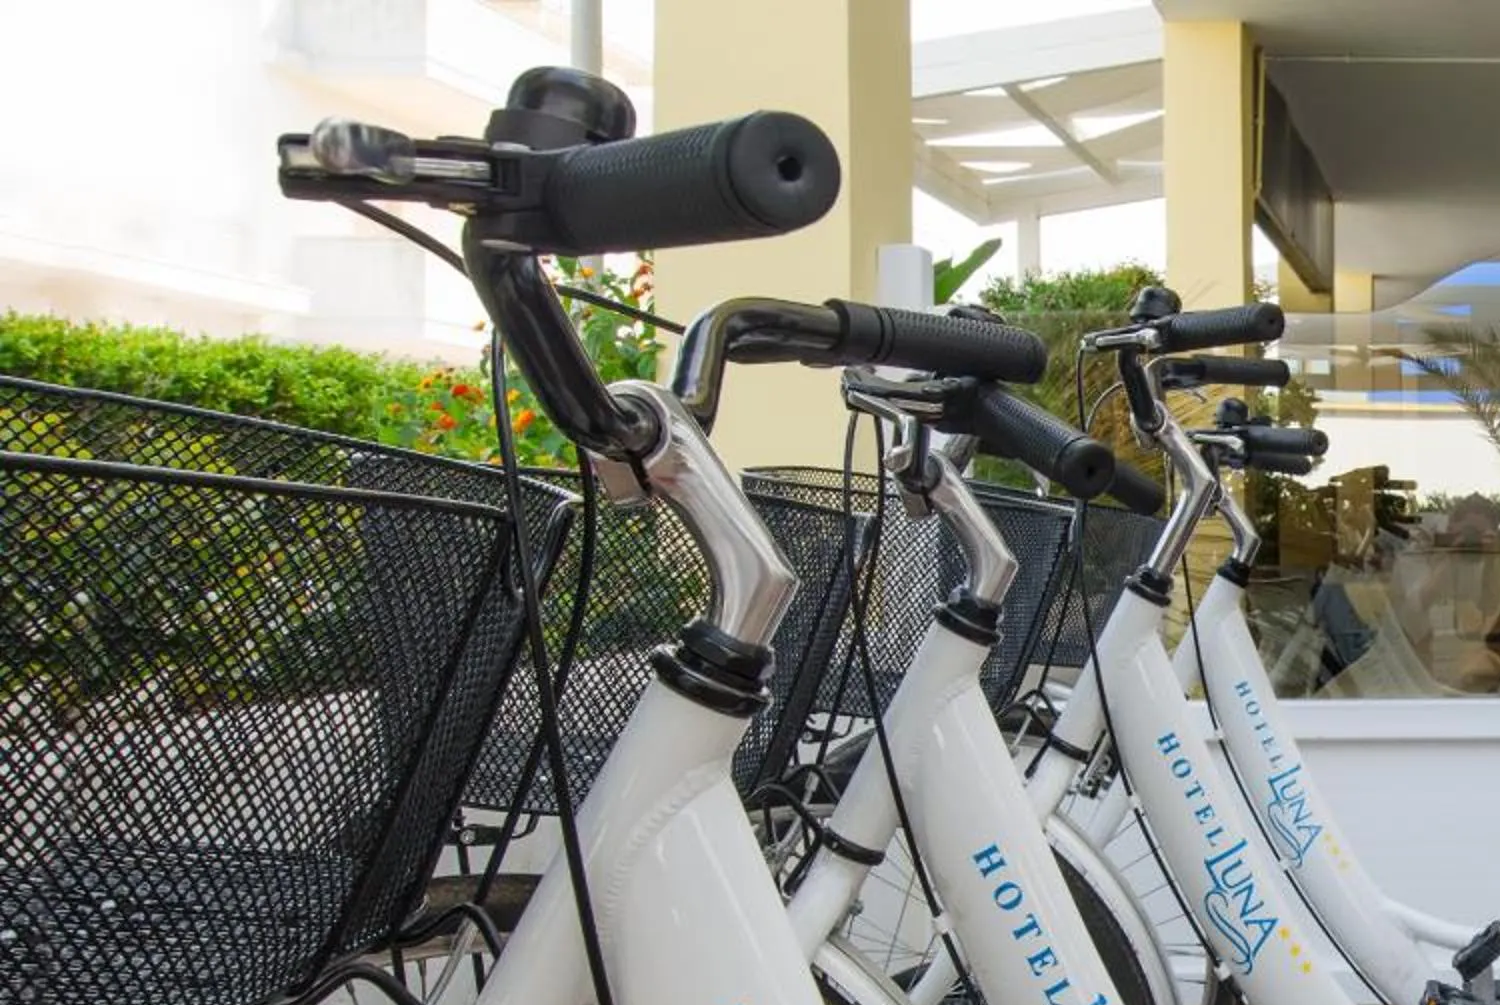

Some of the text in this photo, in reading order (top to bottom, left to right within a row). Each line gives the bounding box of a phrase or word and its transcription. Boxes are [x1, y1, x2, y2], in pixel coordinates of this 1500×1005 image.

[1157, 732, 1279, 960] HOTEL LUNA
[1267, 764, 1322, 863] LUNA
